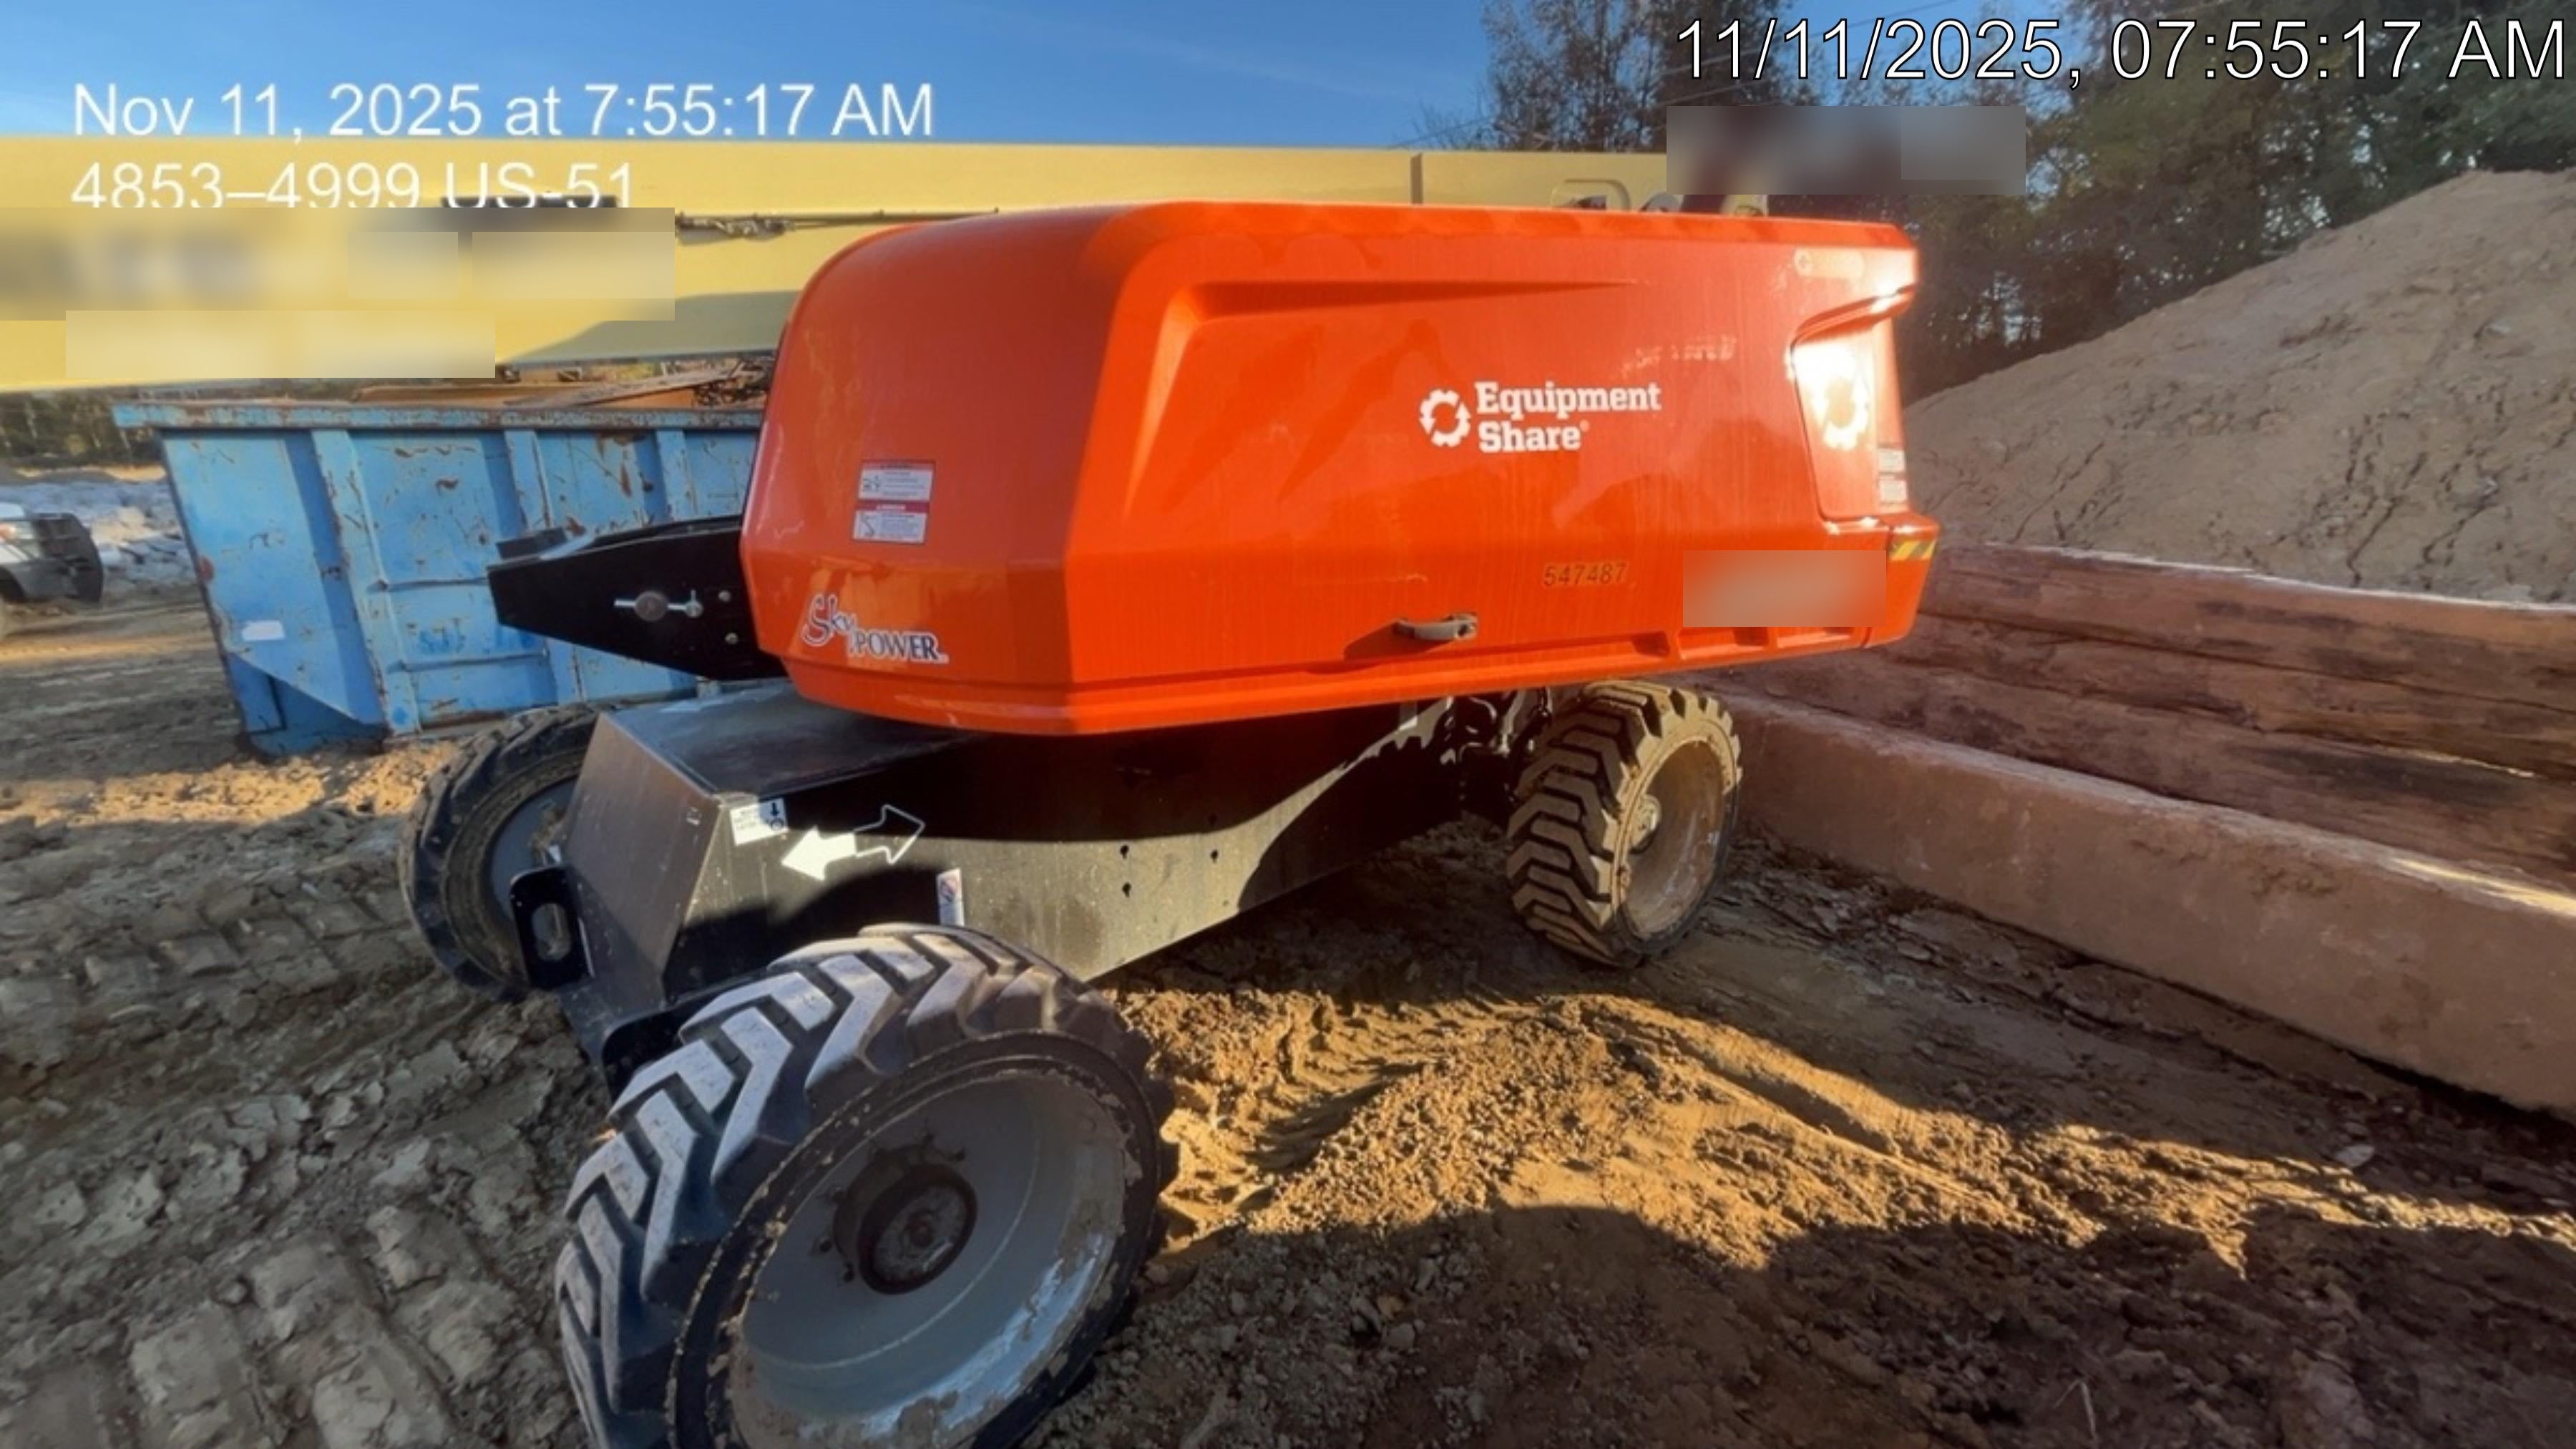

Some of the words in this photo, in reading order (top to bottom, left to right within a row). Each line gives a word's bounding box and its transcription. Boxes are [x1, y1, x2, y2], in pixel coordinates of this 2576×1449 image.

[1475, 381, 1662, 420] Equipment
[1478, 421, 1581, 453] Share
[1543, 562, 1628, 587] 547487
